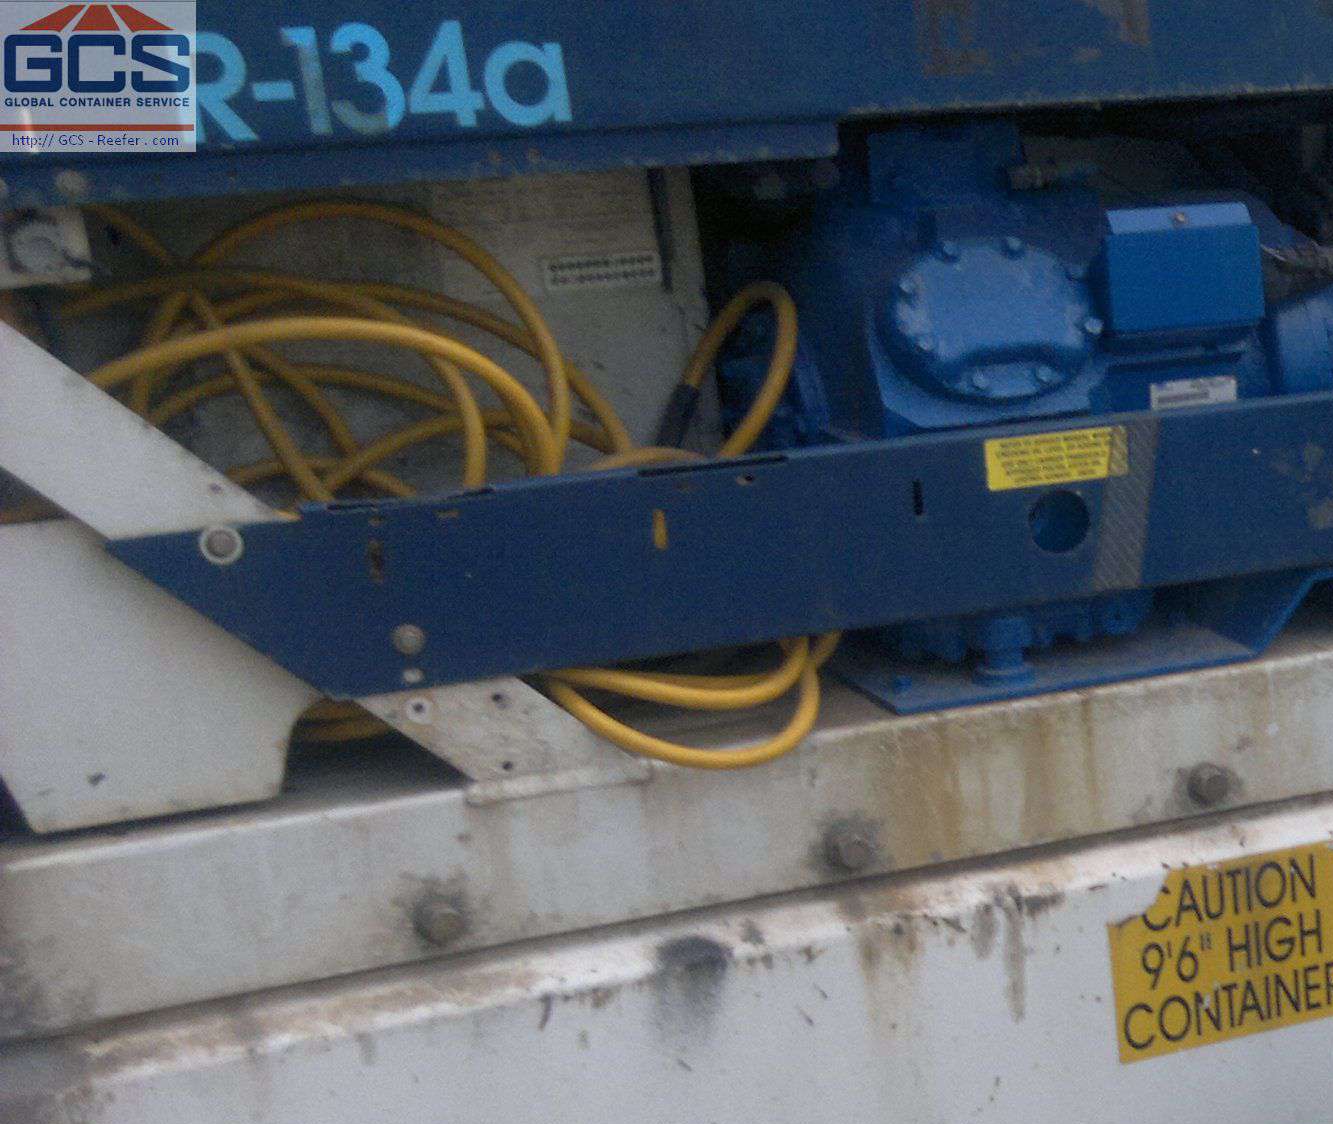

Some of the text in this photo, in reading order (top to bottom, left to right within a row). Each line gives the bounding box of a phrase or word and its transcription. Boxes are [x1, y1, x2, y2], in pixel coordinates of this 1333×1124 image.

[196, 20, 572, 143] R-134a
[1142, 853, 1317, 931] CAUTION
[1226, 908, 1323, 973] HIGH
